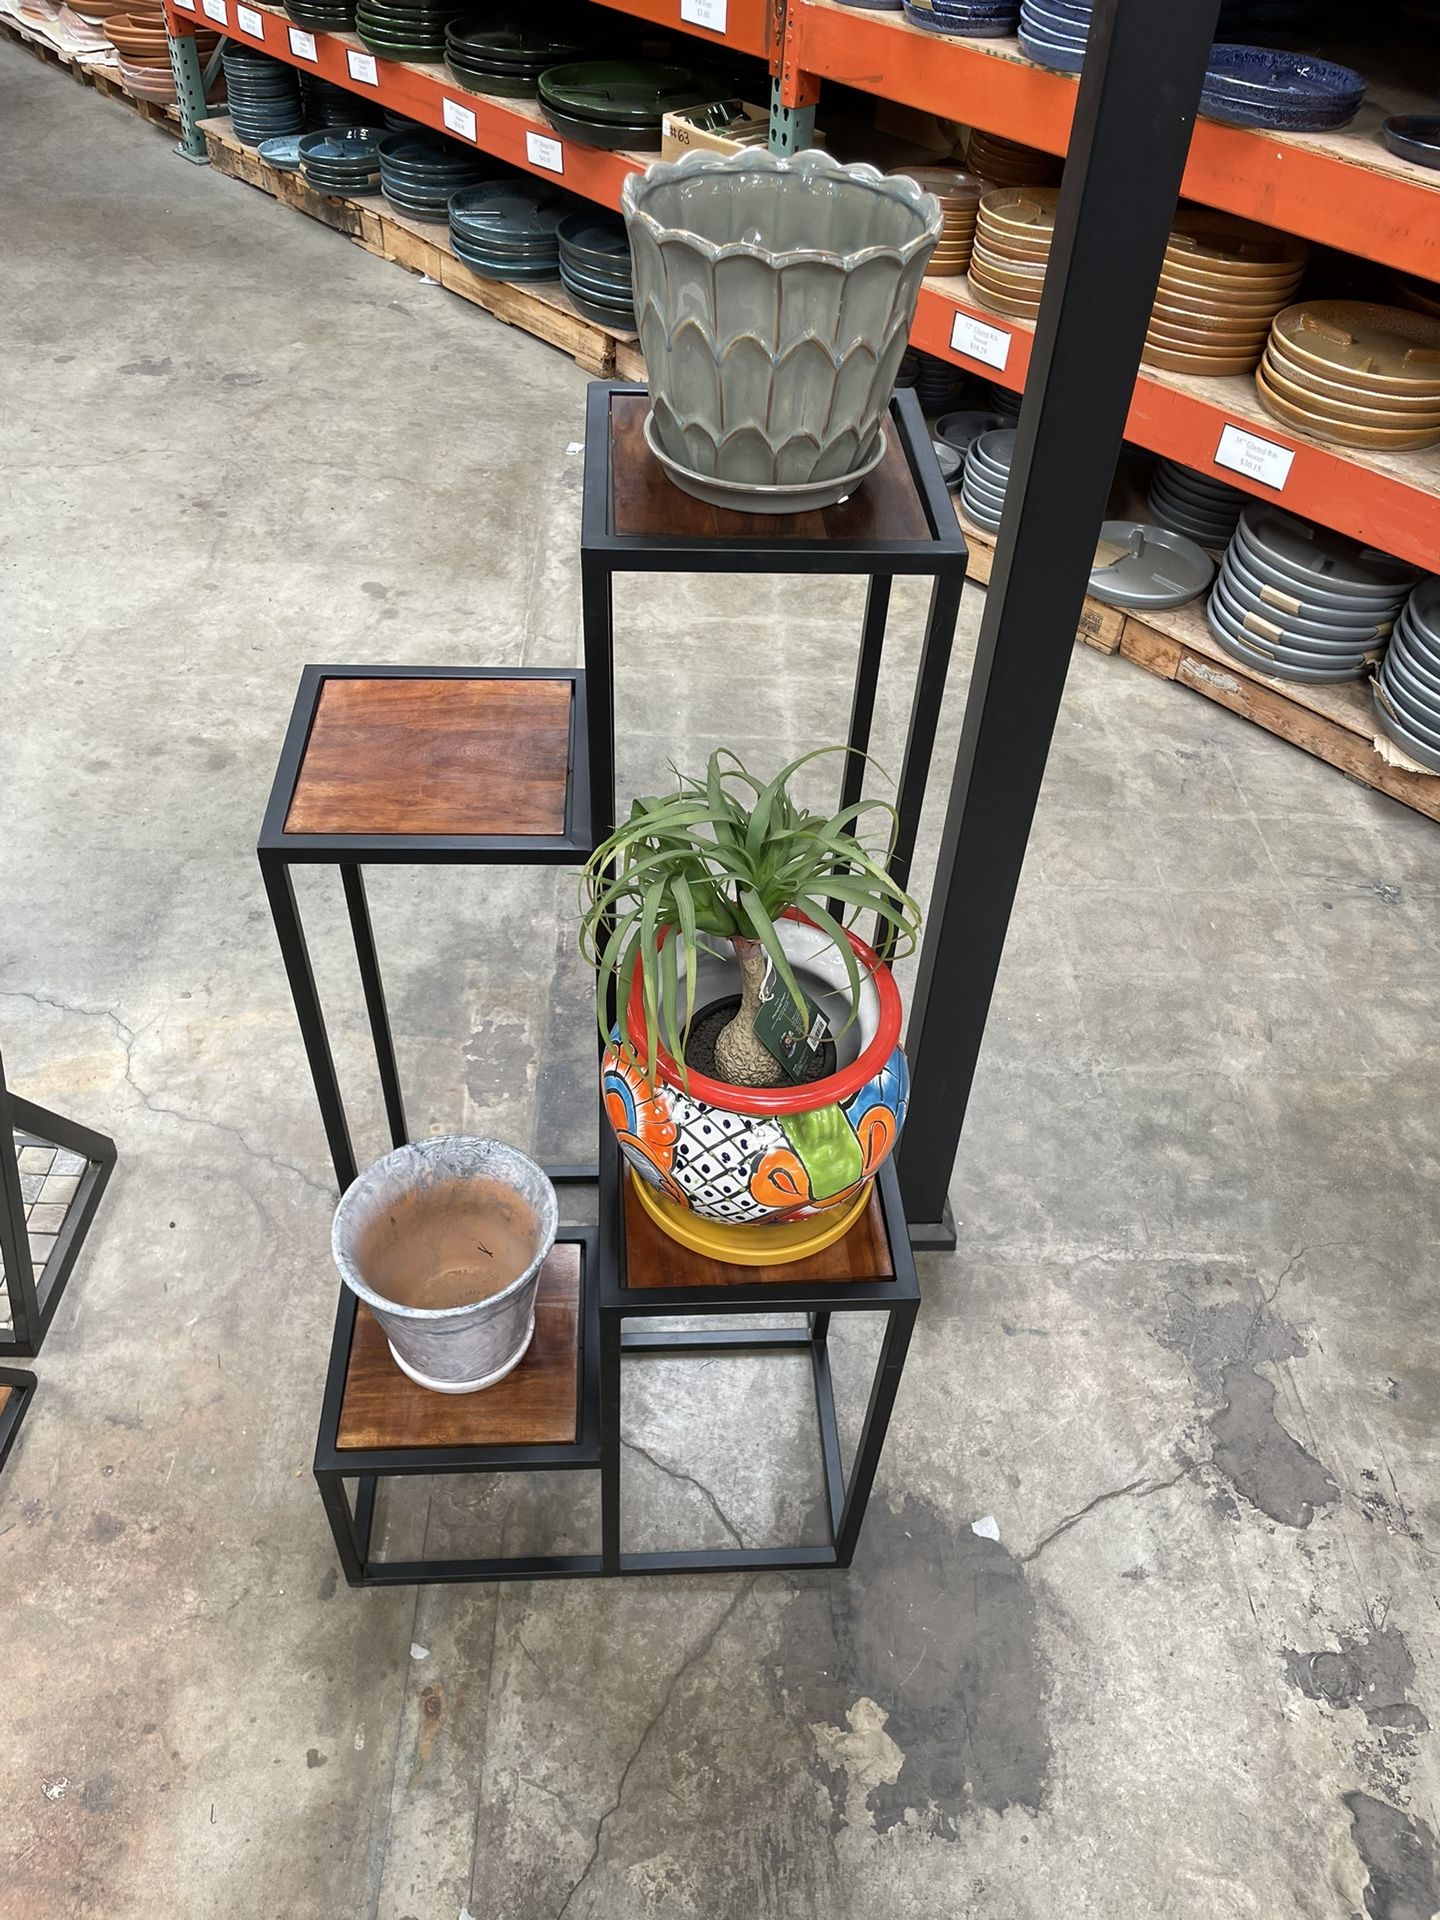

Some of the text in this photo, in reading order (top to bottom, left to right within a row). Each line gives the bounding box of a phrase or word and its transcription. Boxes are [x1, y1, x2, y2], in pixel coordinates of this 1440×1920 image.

[670, 125, 690, 145] #63
[1245, 450, 1265, 463] Saucer
[1246, 440, 1267, 455] Glazed
[1267, 449, 1278, 460] Rib
